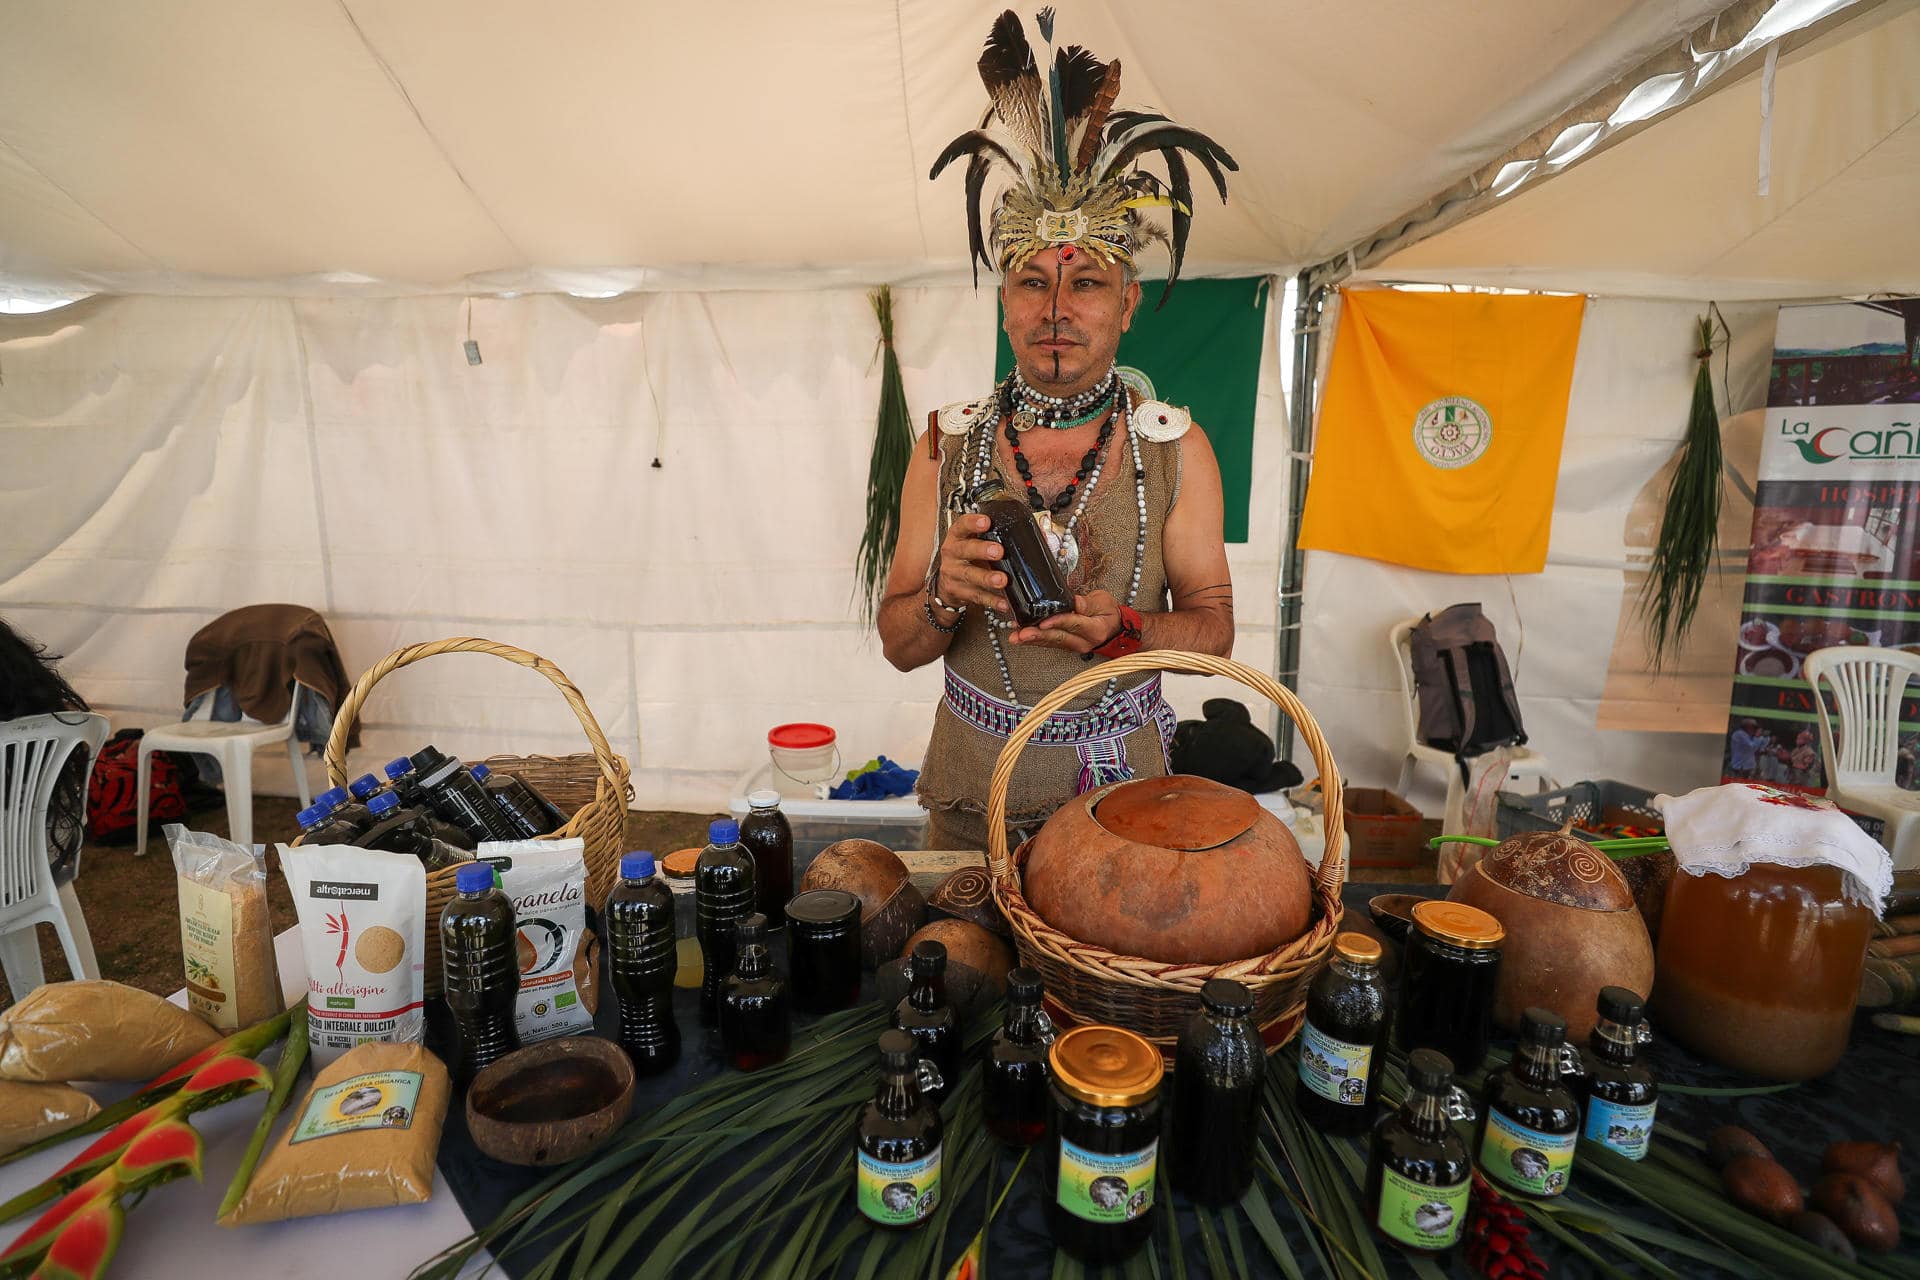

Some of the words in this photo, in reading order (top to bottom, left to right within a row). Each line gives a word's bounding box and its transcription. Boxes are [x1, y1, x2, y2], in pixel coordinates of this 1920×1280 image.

[1782, 418, 1809, 435] La
[1786, 587, 1920, 610] GASTRON
[512, 882, 583, 915] ganela
[324, 1020, 362, 1032] INTEGRALE
[364, 1019, 396, 1032] DULCITA
